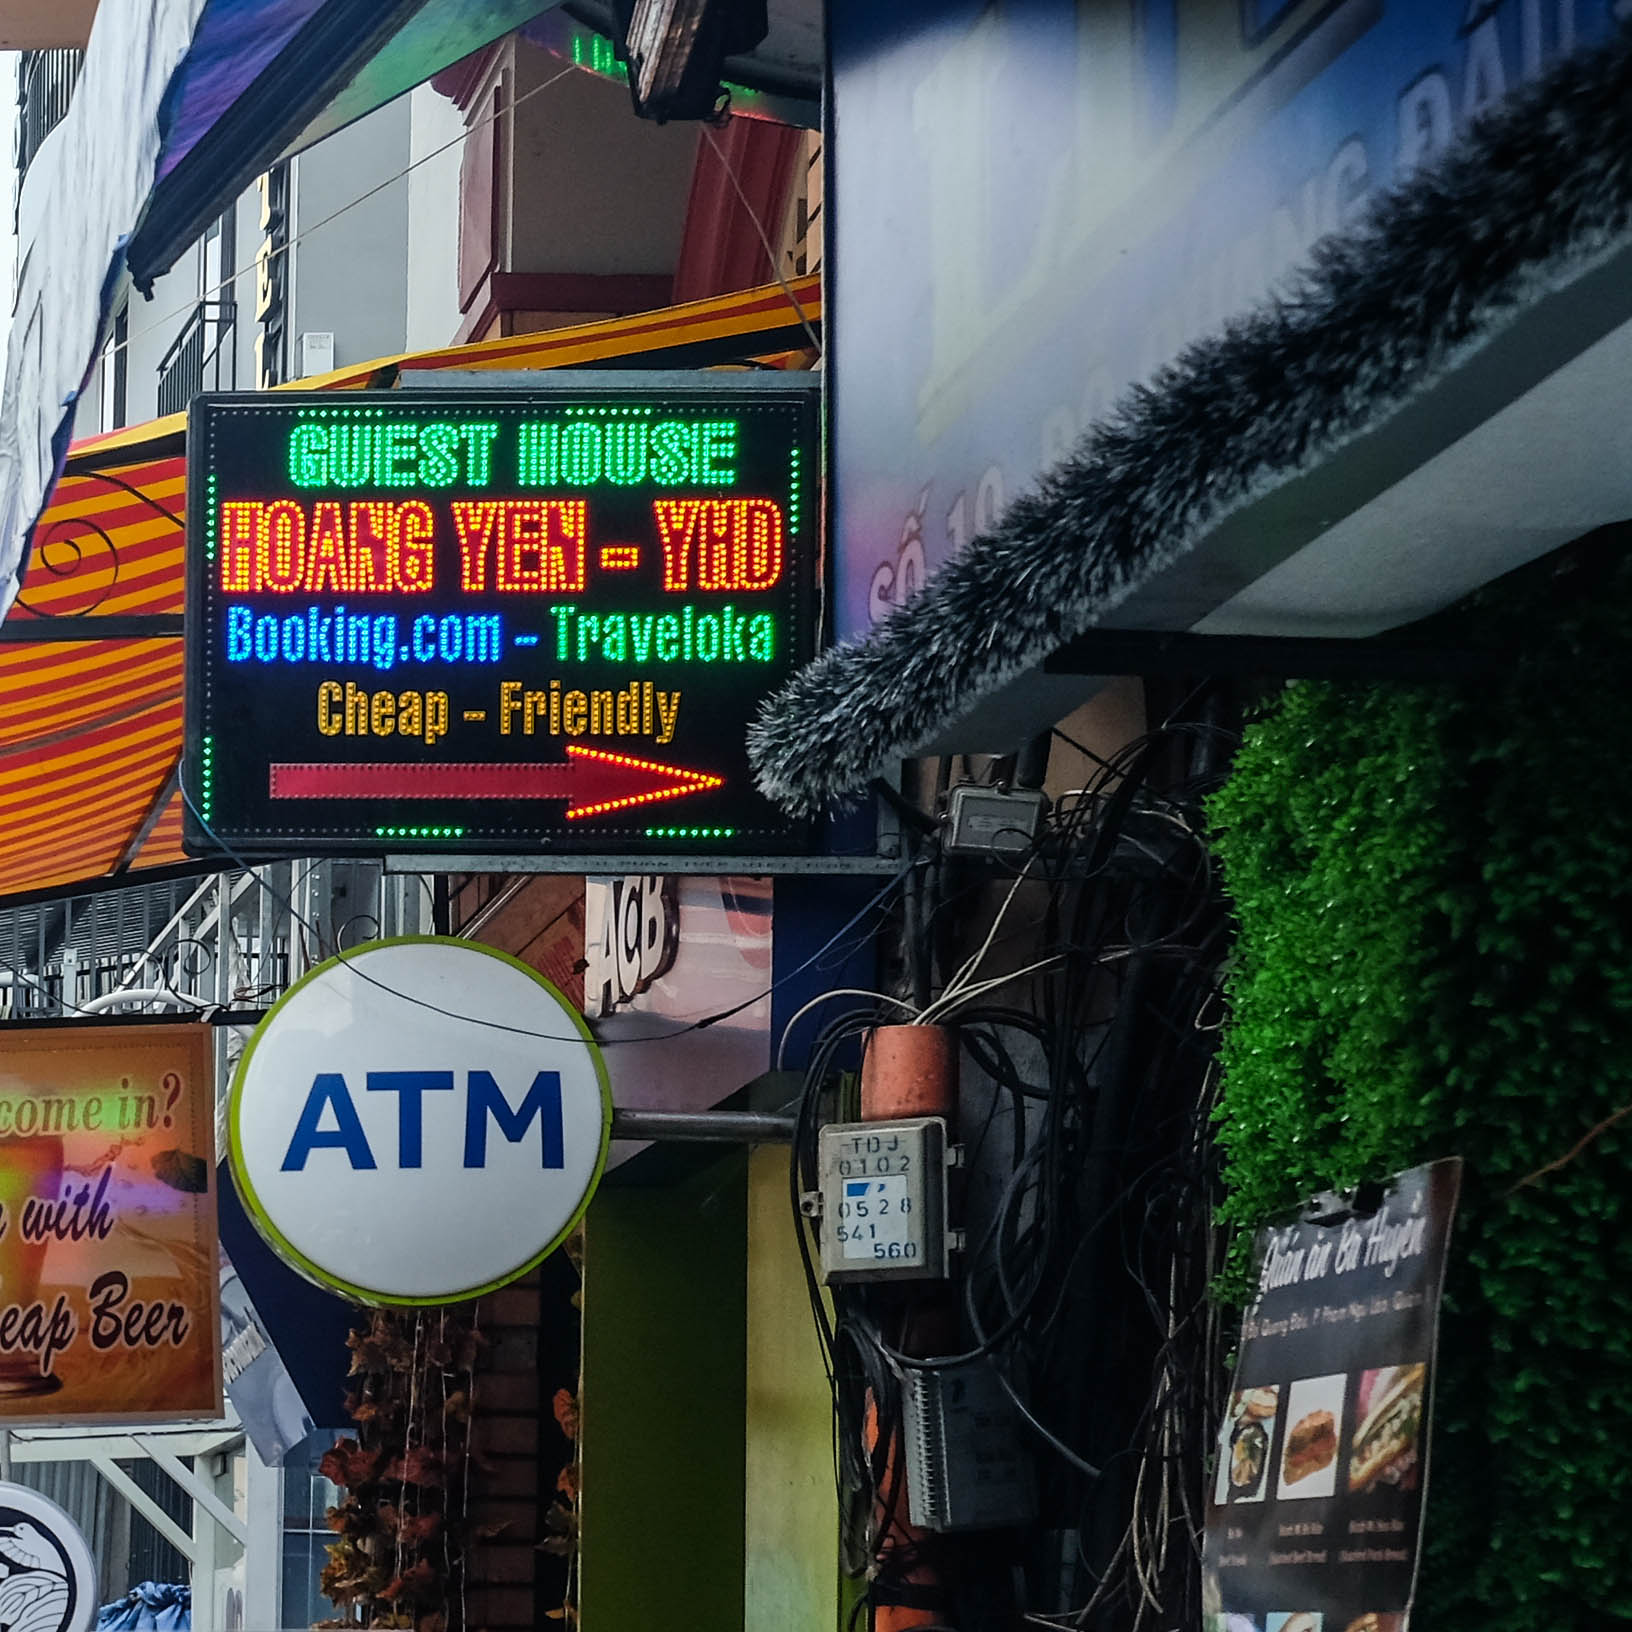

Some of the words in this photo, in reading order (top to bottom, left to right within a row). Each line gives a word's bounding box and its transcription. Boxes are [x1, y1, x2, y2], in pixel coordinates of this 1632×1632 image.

[288, 421, 498, 488] GUEST
[517, 421, 738, 487] HOUSE
[220, 500, 434, 593] HOANG
[450, 500, 587, 593] YEN
[226, 605, 502, 670] Booking.com
[550, 604, 775, 663] Traveloka
[317, 680, 449, 744] Cheap
[499, 680, 682, 745] Friendly
[596, 876, 666, 1018] ACB
[118, 1072, 181, 1130] in?
[280, 1070, 565, 1172] ATM
[839, 1155, 911, 1176] 0102
[22, 1164, 114, 1243] with
[837, 1223, 876, 1242] 541
[838, 1197, 912, 1219] 0528
[873, 1242, 917, 1260] 560
[87, 1270, 191, 1350] Beer
